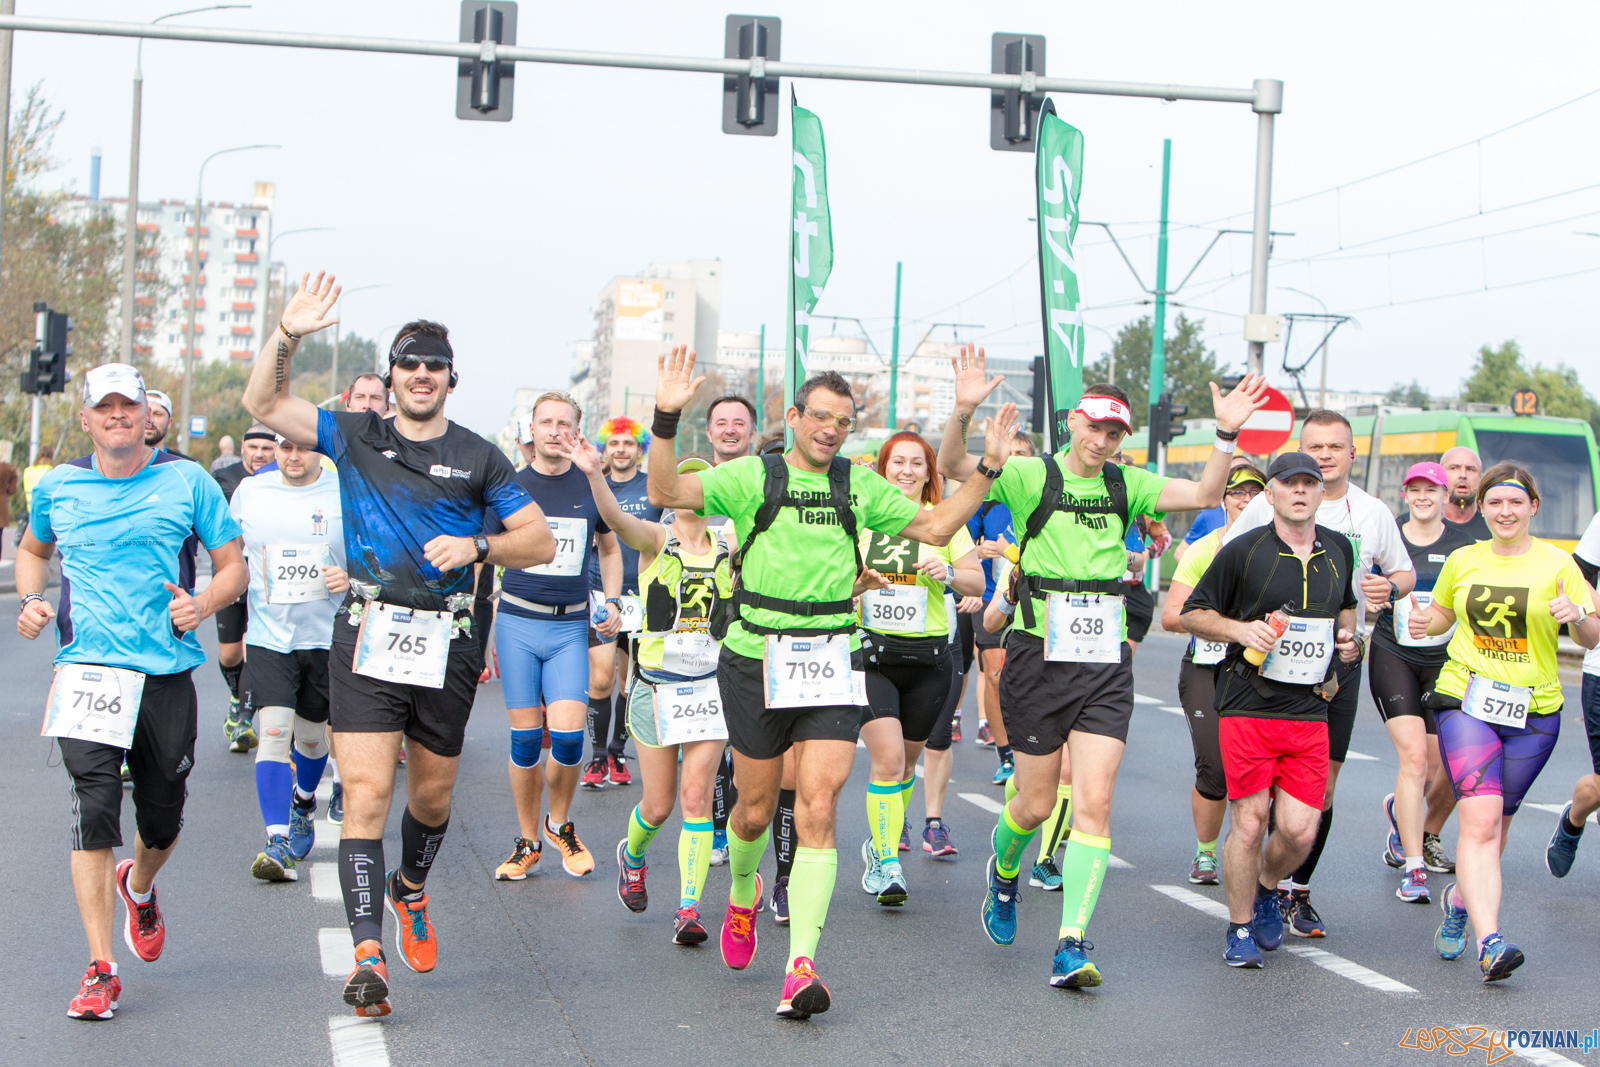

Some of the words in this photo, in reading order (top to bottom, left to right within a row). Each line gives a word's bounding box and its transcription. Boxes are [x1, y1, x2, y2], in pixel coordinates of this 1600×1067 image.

[1514, 391, 1537, 414] 12
[618, 503, 647, 511] OTEL
[796, 507, 841, 526] Team
[277, 564, 319, 580] 2996
[872, 603, 917, 621] 3809
[1070, 617, 1104, 636] 638
[387, 632, 428, 655] 765
[1278, 639, 1325, 659] 5903
[1482, 638, 1519, 652] night
[785, 661, 835, 680] 7196
[72, 690, 122, 715] 7166
[672, 699, 719, 719] 2645
[1482, 696, 1526, 720] 5718
[348, 853, 375, 917] Kalenji
